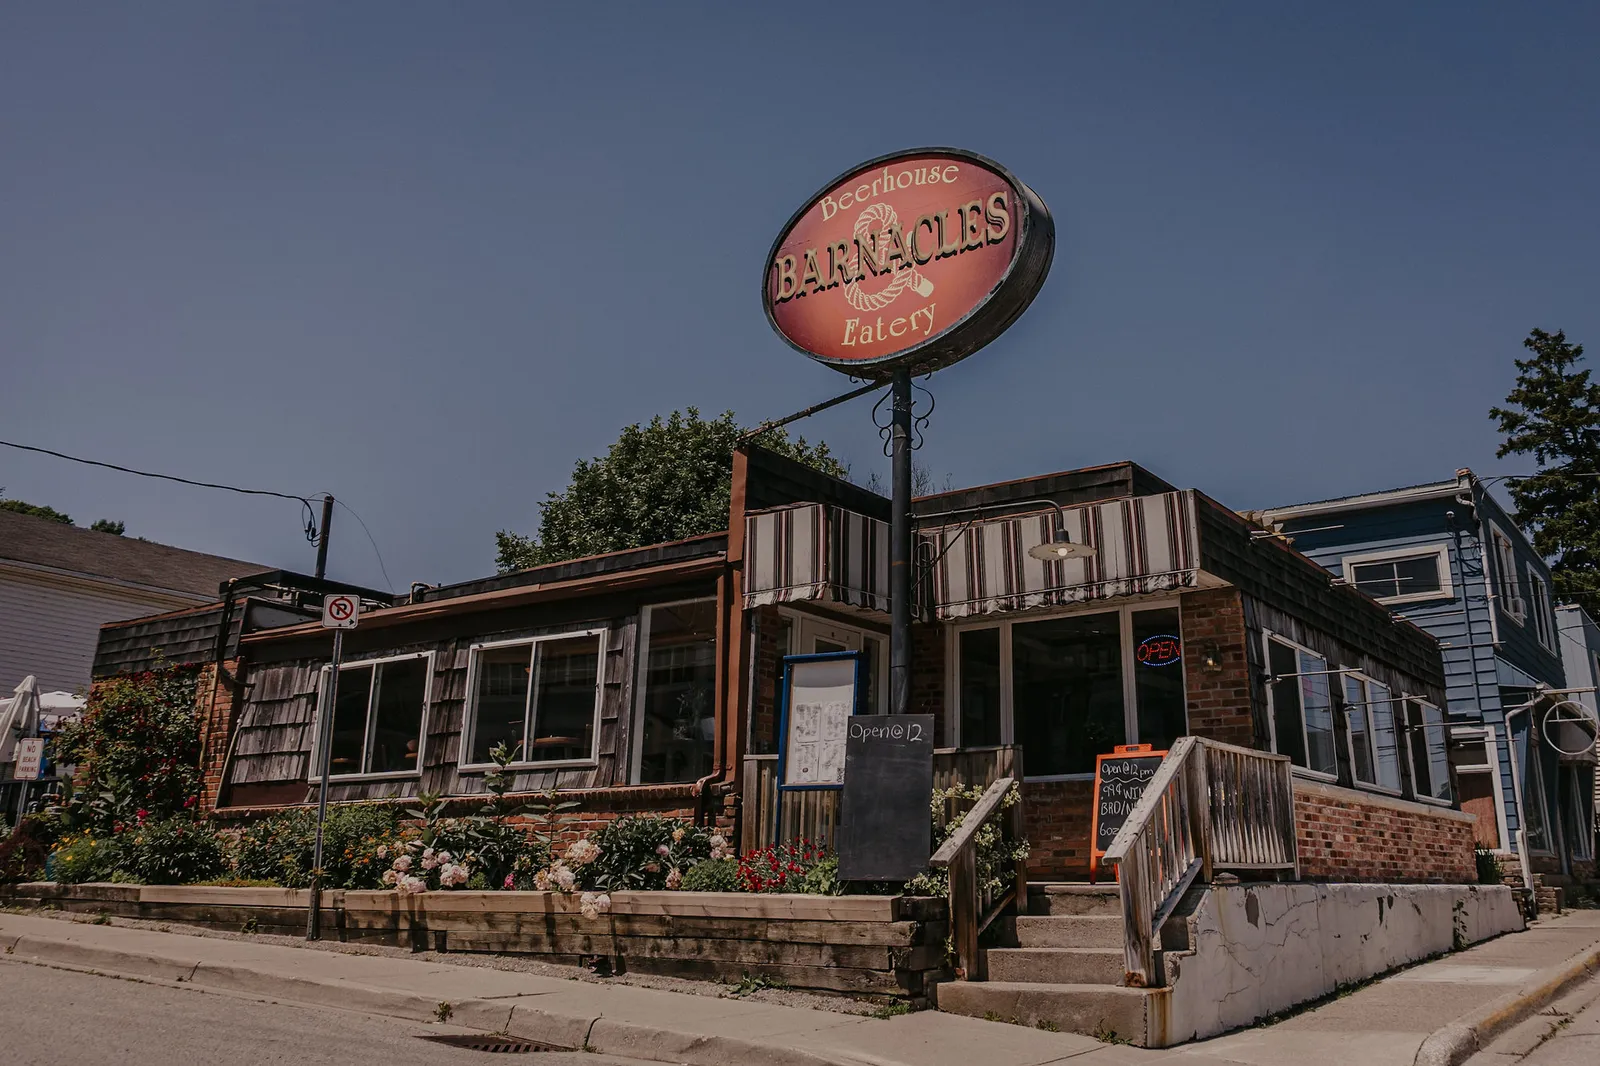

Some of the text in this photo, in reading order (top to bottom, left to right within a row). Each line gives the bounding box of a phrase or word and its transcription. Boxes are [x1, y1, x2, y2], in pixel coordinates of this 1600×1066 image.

[818, 163, 960, 222] Beerhouse
[774, 190, 1011, 305] BARNACLES
[840, 303, 937, 347] Eatery
[1137, 641, 1182, 661] OPEN
[906, 723, 923, 742] 12
[26, 745, 37, 754] NO
